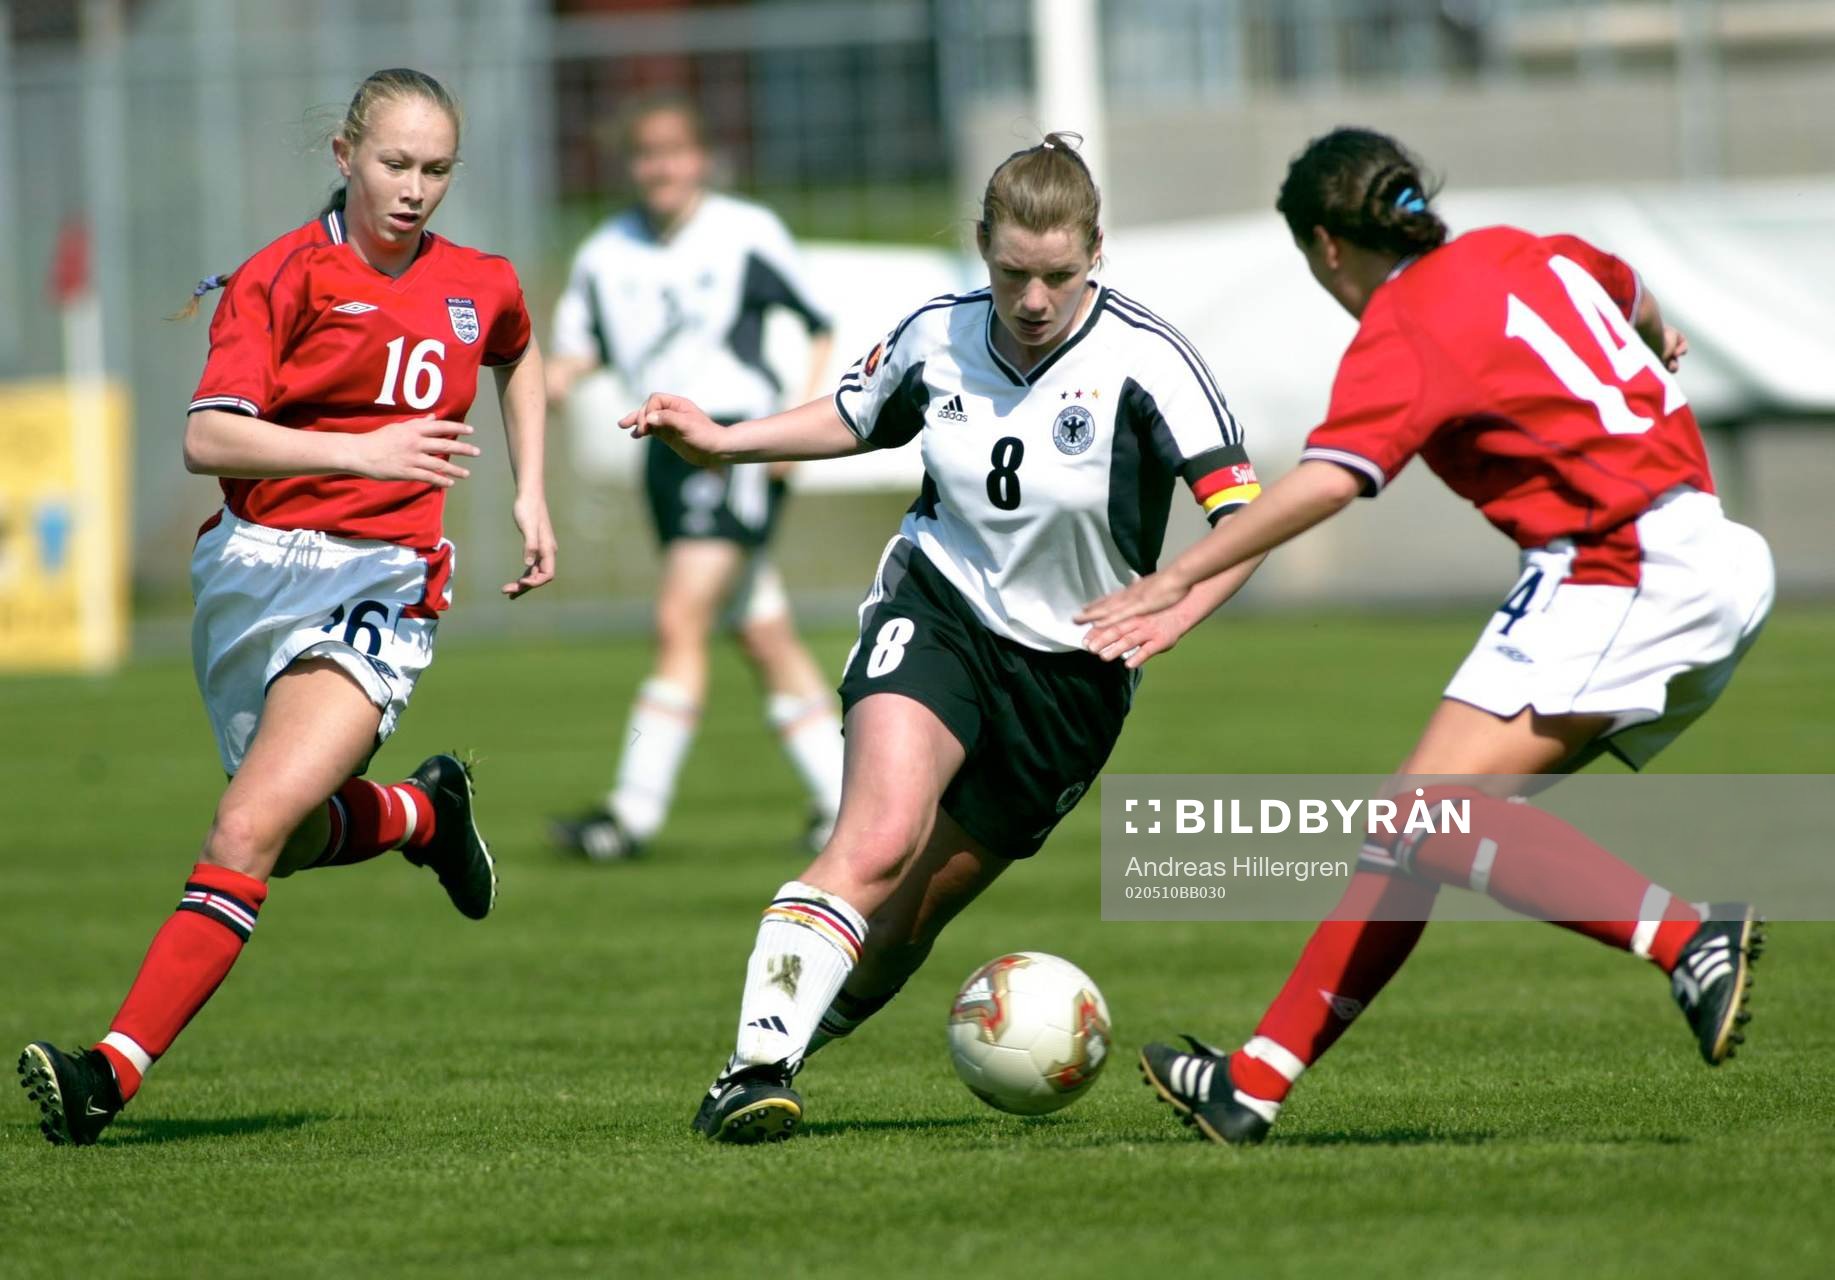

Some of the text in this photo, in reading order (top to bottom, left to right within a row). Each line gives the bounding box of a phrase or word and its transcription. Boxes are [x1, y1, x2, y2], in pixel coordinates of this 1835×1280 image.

[374, 335, 446, 410] 16
[1505, 254, 1688, 434] 14
[937, 410, 968, 422] adidas
[986, 436, 1025, 511] 8
[866, 617, 915, 679] 8
